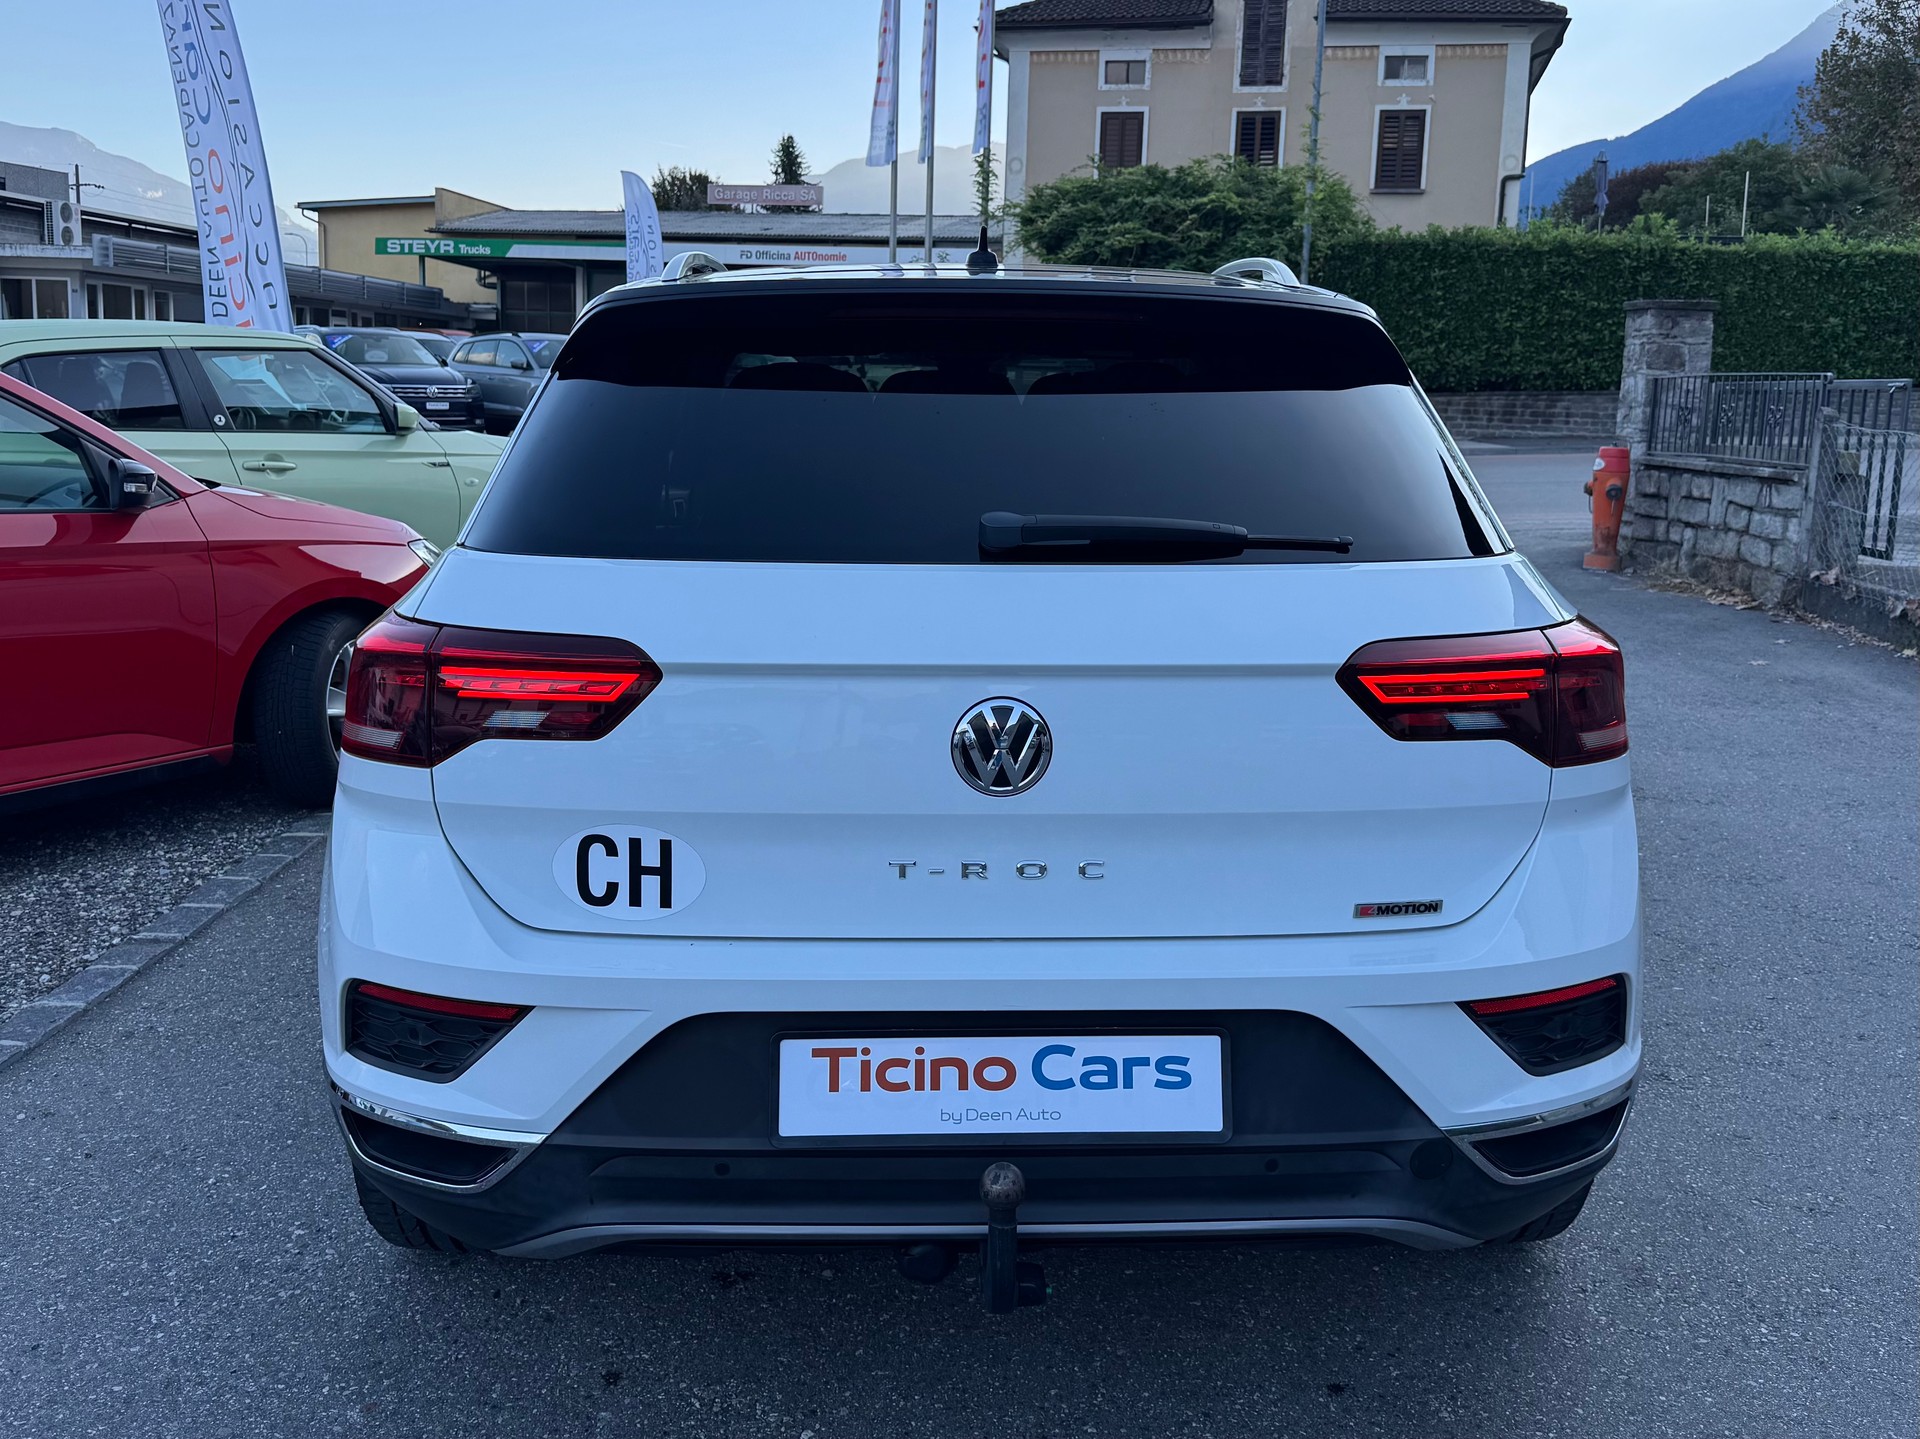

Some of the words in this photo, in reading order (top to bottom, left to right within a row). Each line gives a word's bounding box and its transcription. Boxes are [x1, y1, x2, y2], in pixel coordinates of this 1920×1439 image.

[714, 187, 757, 202] Garage
[763, 188, 795, 200] Ricca
[800, 189, 817, 201] SA
[386, 239, 455, 254] STEYR
[458, 244, 491, 256] Trucks
[755, 250, 791, 261] Officina
[793, 251, 847, 262] AUTOnomie
[951, 696, 1053, 797] VW
[575, 833, 673, 909] CH
[811, 1045, 1018, 1093] Ticino
[1031, 1044, 1193, 1090] Cars
[940, 1108, 963, 1125] by
[965, 1108, 1013, 1122] Deen
[1015, 1107, 1062, 1121] Auto
